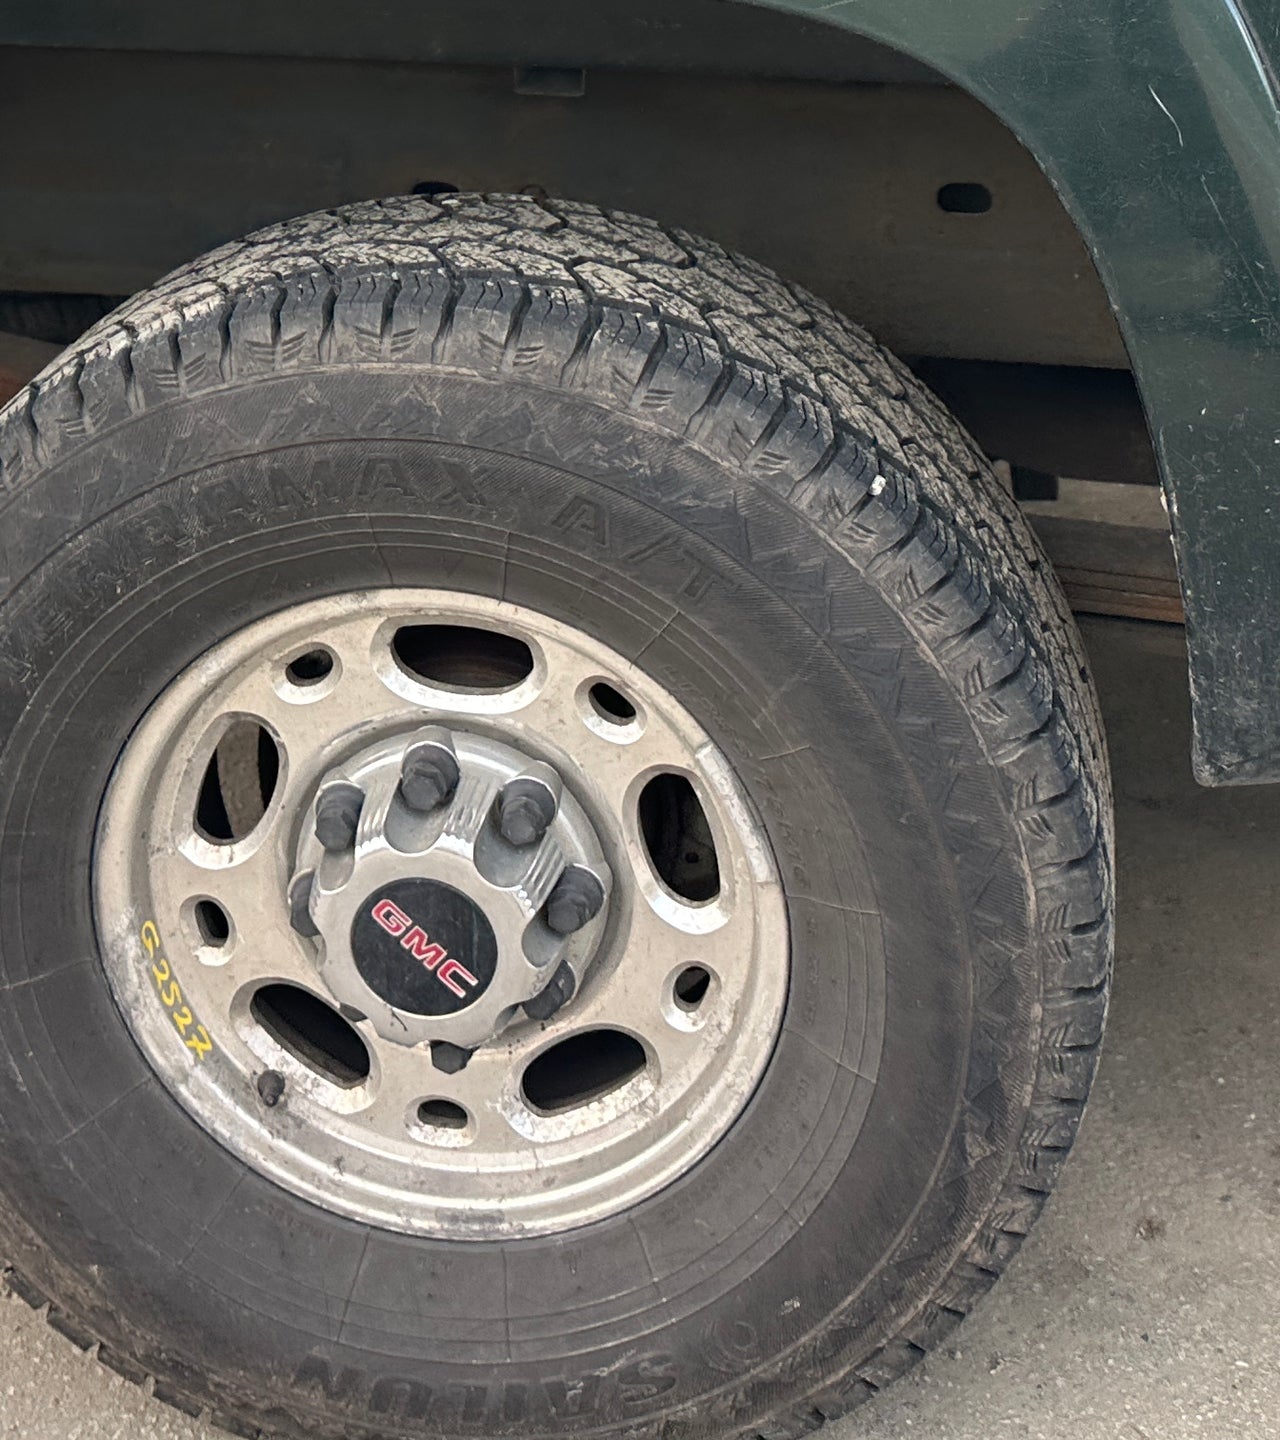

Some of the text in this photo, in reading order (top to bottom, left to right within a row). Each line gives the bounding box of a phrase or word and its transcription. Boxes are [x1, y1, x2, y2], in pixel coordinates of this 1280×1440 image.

[549, 492, 744, 601] A/T
[140, 919, 214, 1061] G2527
[371, 898, 479, 998] GMC
[292, 1351, 677, 1424] SAILUN
